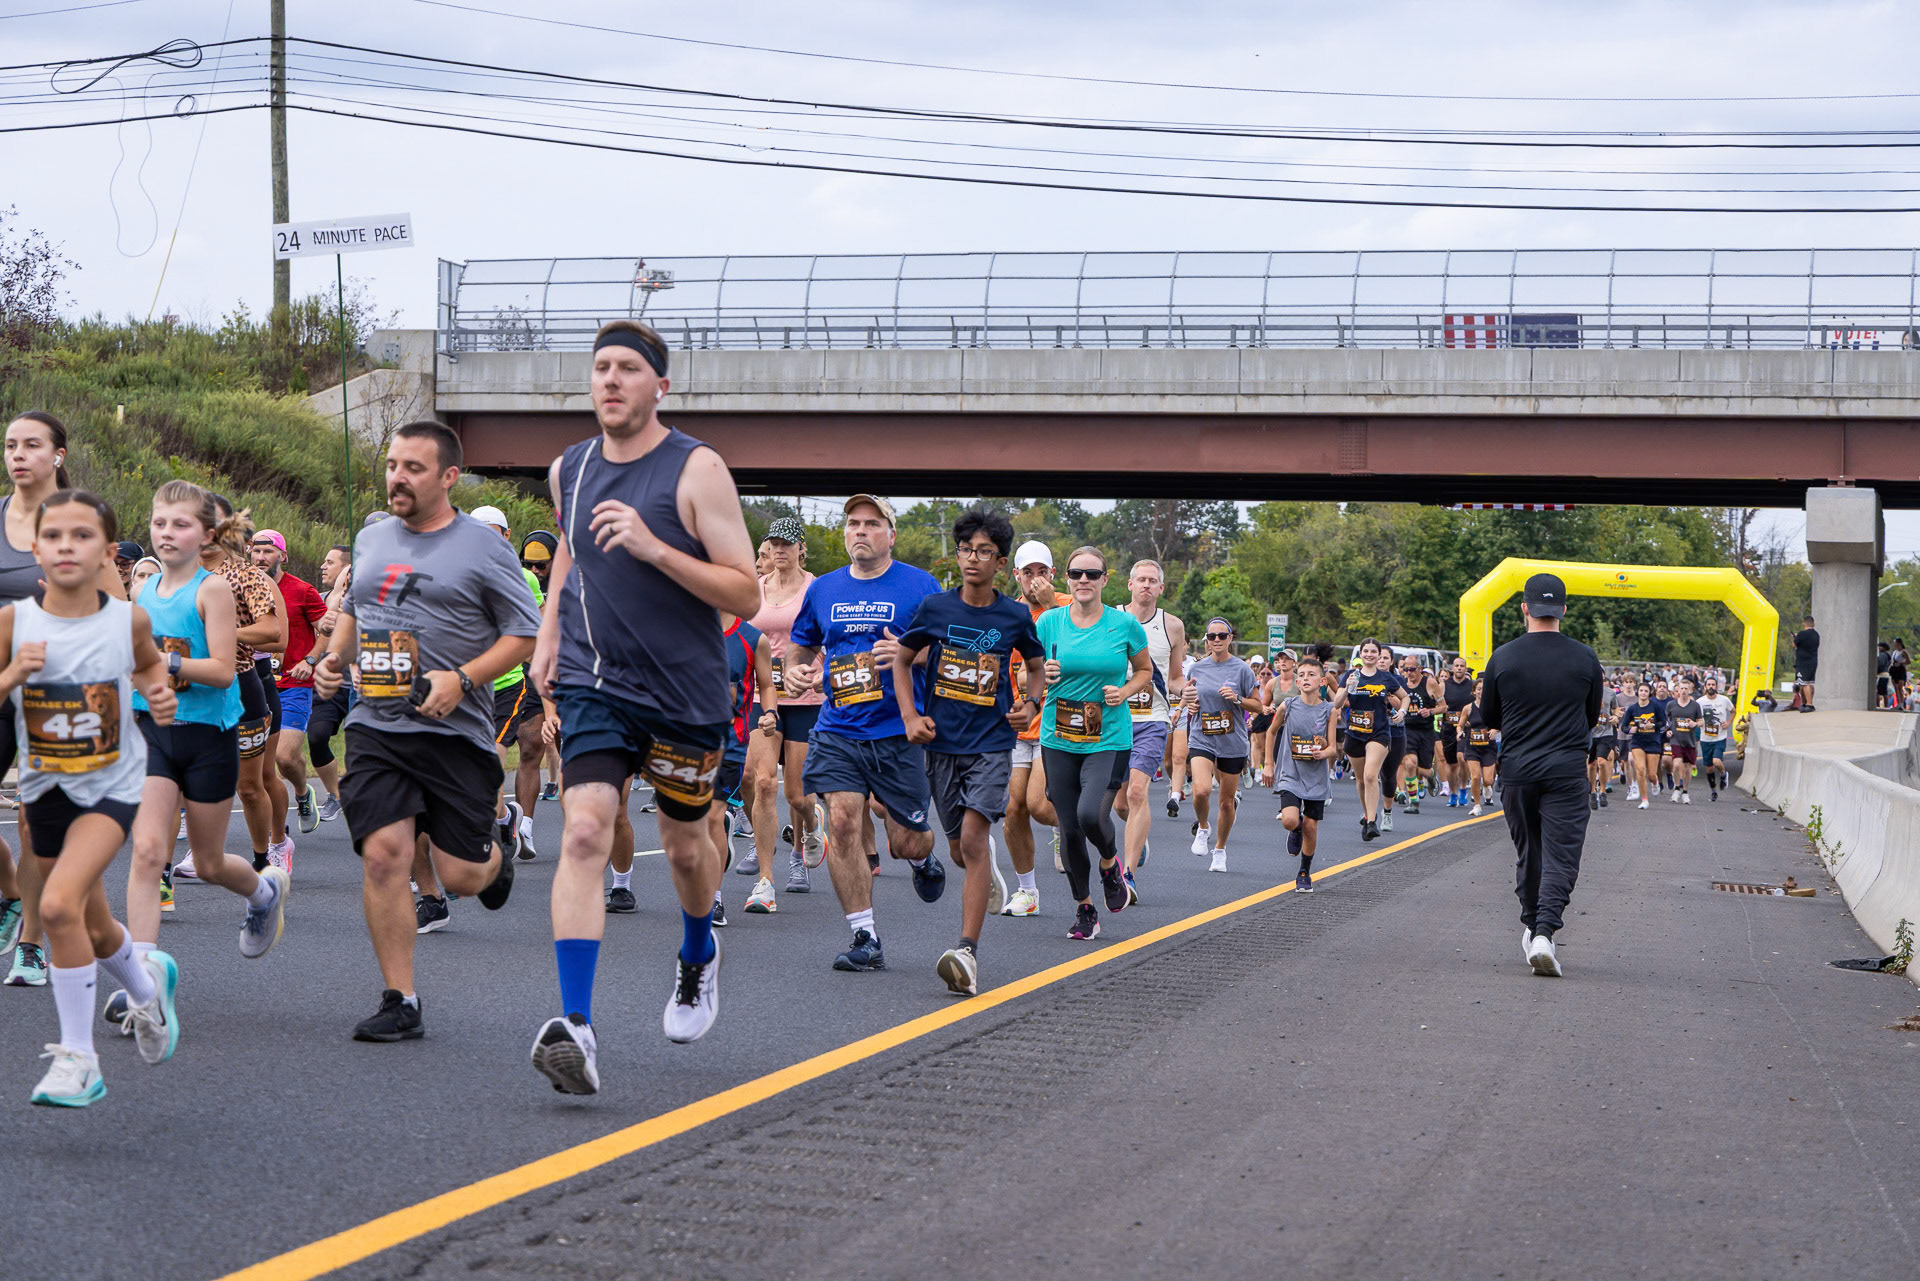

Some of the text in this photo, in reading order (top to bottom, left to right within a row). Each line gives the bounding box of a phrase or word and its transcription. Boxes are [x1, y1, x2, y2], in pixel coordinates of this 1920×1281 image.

[277, 224, 407, 252] 24 MINUTE PACE
[837, 605, 865, 613] POWER
[877, 605, 889, 613] US
[844, 624, 869, 633] JDRF
[1271, 639, 1282, 647] 206
[360, 650, 413, 673] 255
[942, 655, 966, 665] CHASE
[834, 668, 871, 688] 135
[943, 664, 994, 685] 347
[42, 711, 102, 740] 42
[1069, 713, 1084, 727] 2
[1205, 719, 1230, 730] 128
[1351, 716, 1371, 725] 193
